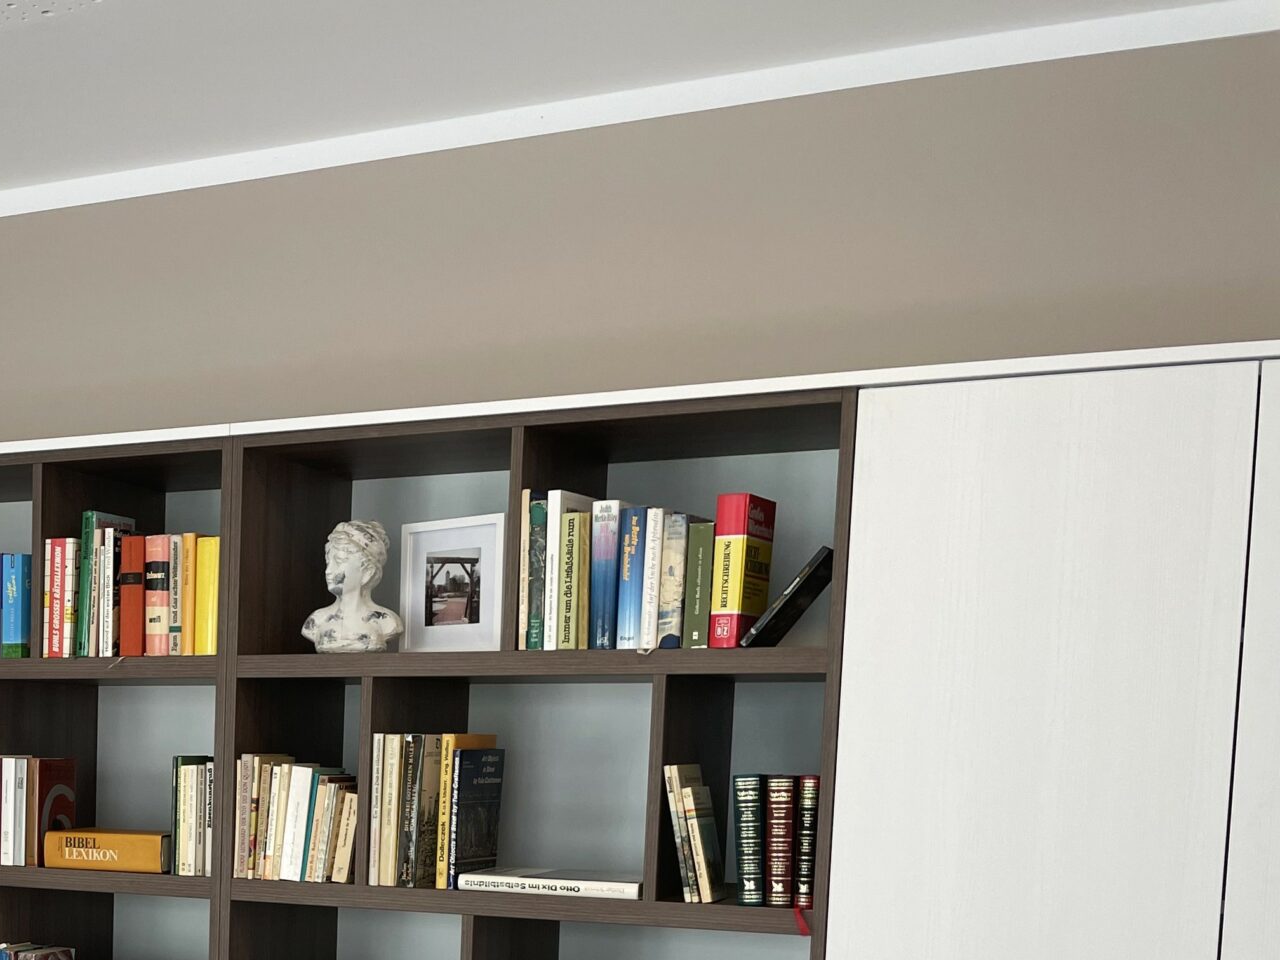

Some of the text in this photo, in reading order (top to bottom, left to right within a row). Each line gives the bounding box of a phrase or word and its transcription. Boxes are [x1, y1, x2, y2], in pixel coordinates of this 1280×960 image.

[52, 546, 62, 598] RÄTSELLEXIKON
[720, 541, 731, 608] RECHTSCHREIBUNG
[562, 518, 575, 644] Immer um die Litfaßsäule rum
[65, 836, 100, 849] BIBEL
[438, 821, 446, 862] Dolleczek
[65, 848, 119, 861] LEXIKON
[464, 880, 526, 890] Selbstbildnis
[542, 884, 557, 892] Dix
[559, 885, 580, 893] Otto
